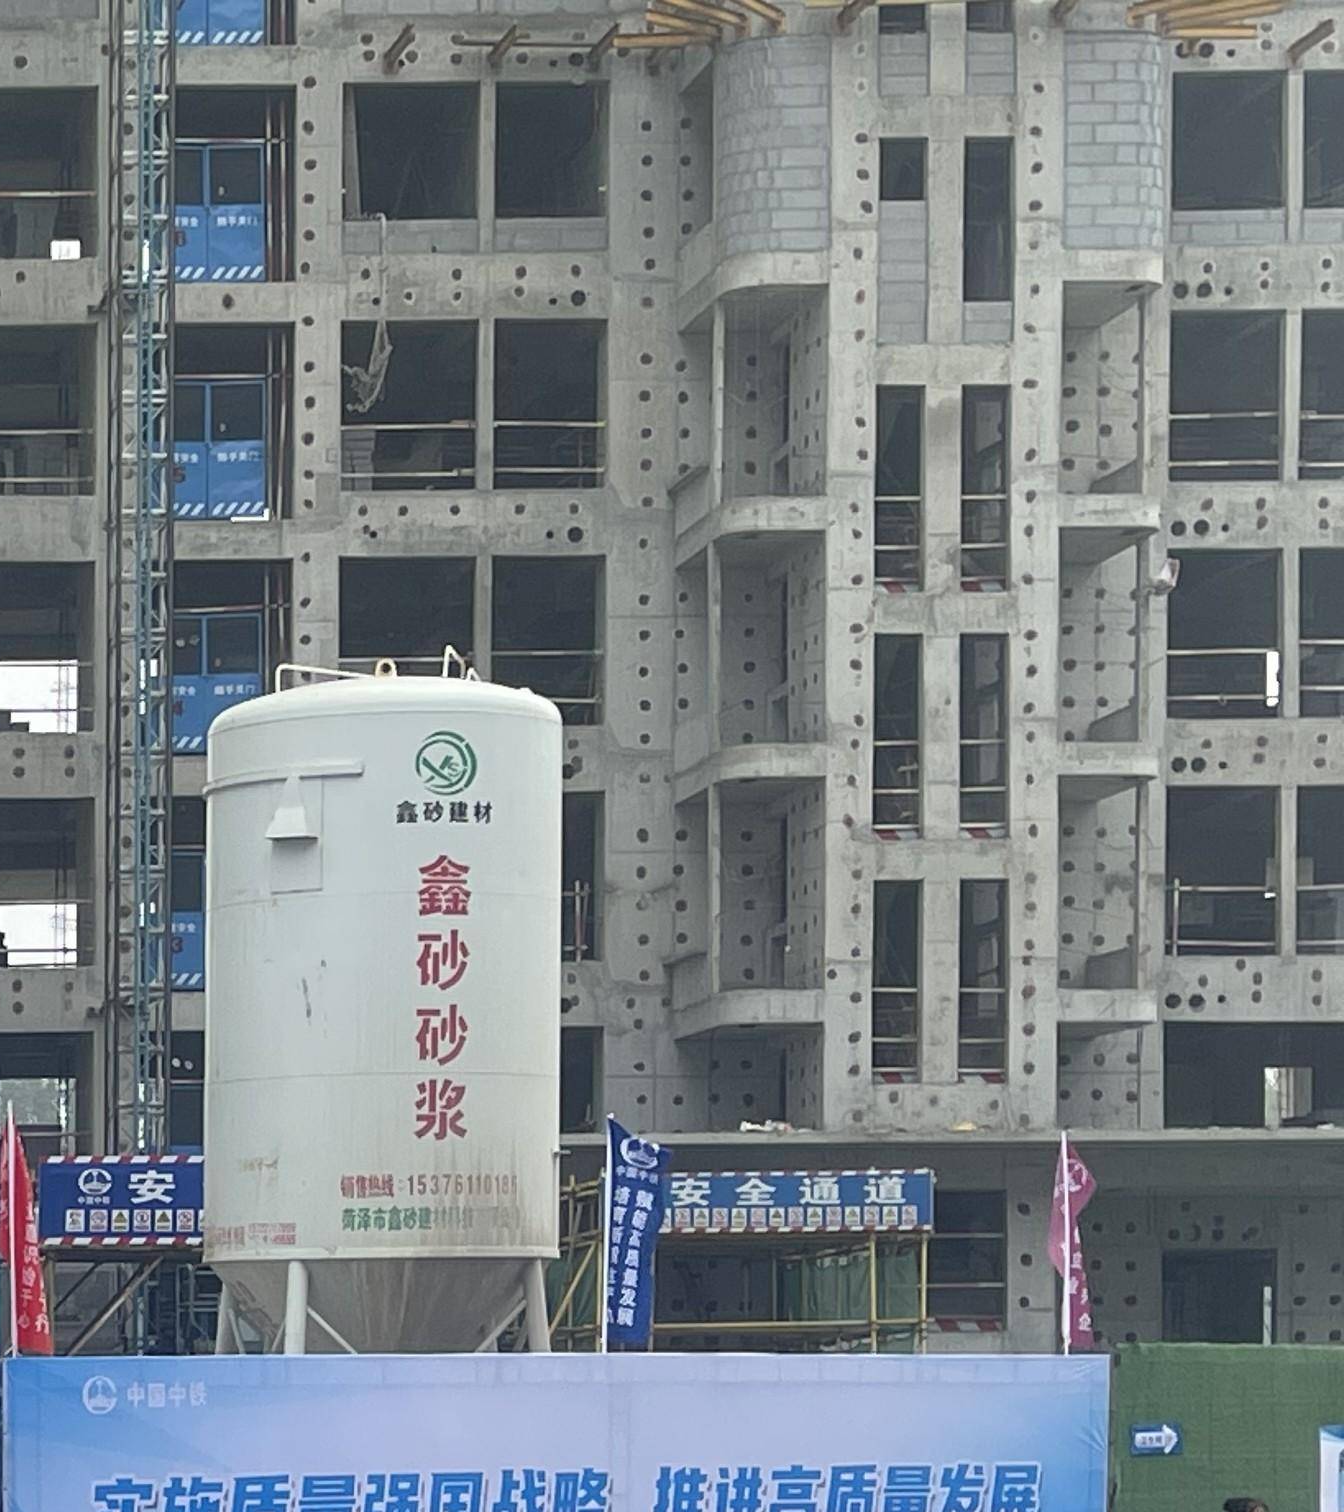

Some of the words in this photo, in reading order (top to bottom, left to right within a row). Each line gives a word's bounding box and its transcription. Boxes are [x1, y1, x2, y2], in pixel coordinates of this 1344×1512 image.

[395, 801, 494, 825] 鑫砂建材
[414, 854, 471, 1141] 鑫砂砂浆
[128, 1169, 176, 1204] 安
[670, 1176, 906, 1206] 安全通道
[126, 1381, 209, 1404] 中国中铁
